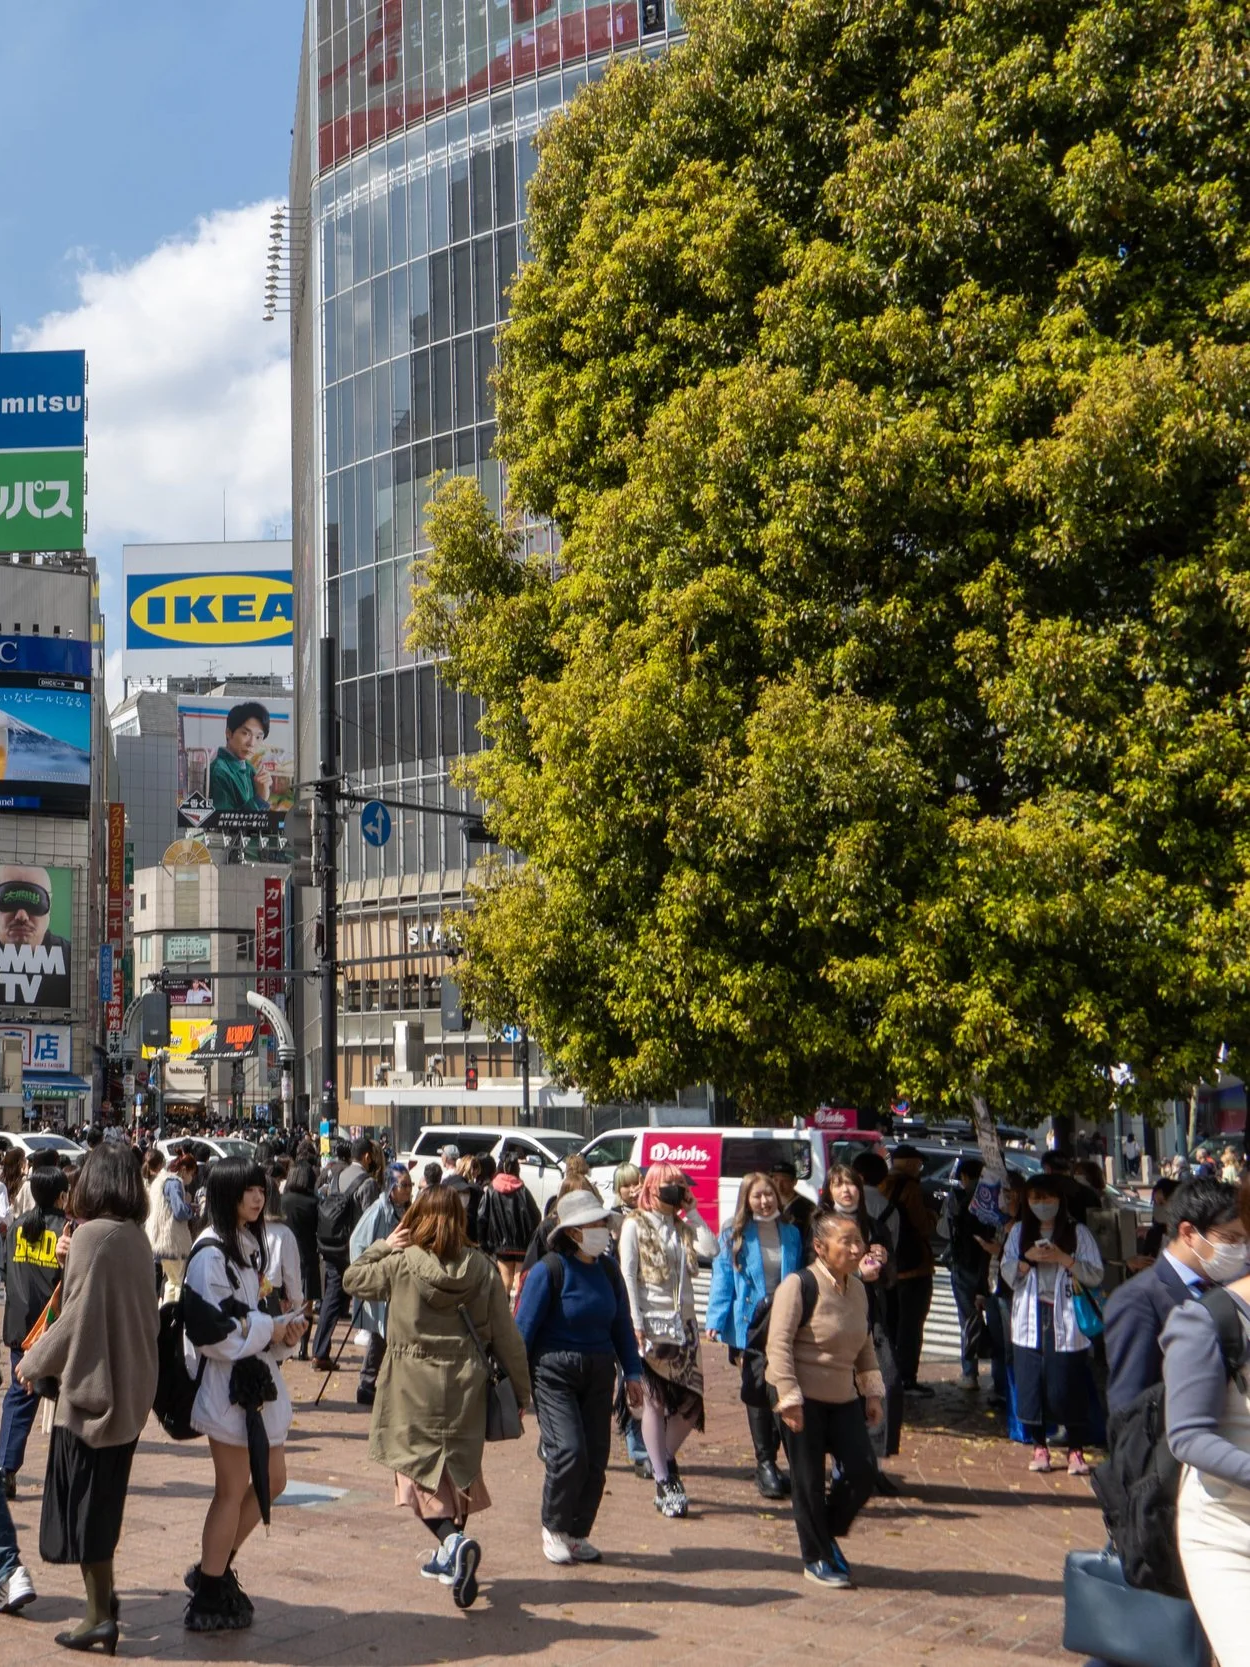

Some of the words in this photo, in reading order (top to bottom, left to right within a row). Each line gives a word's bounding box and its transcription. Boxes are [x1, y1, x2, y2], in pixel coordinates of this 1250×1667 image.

[147, 593, 293, 625] IKEA
[110, 806, 122, 892] クスリのことなら
[266, 887, 280, 958] カラオケ
[0, 973, 42, 1004] TV
